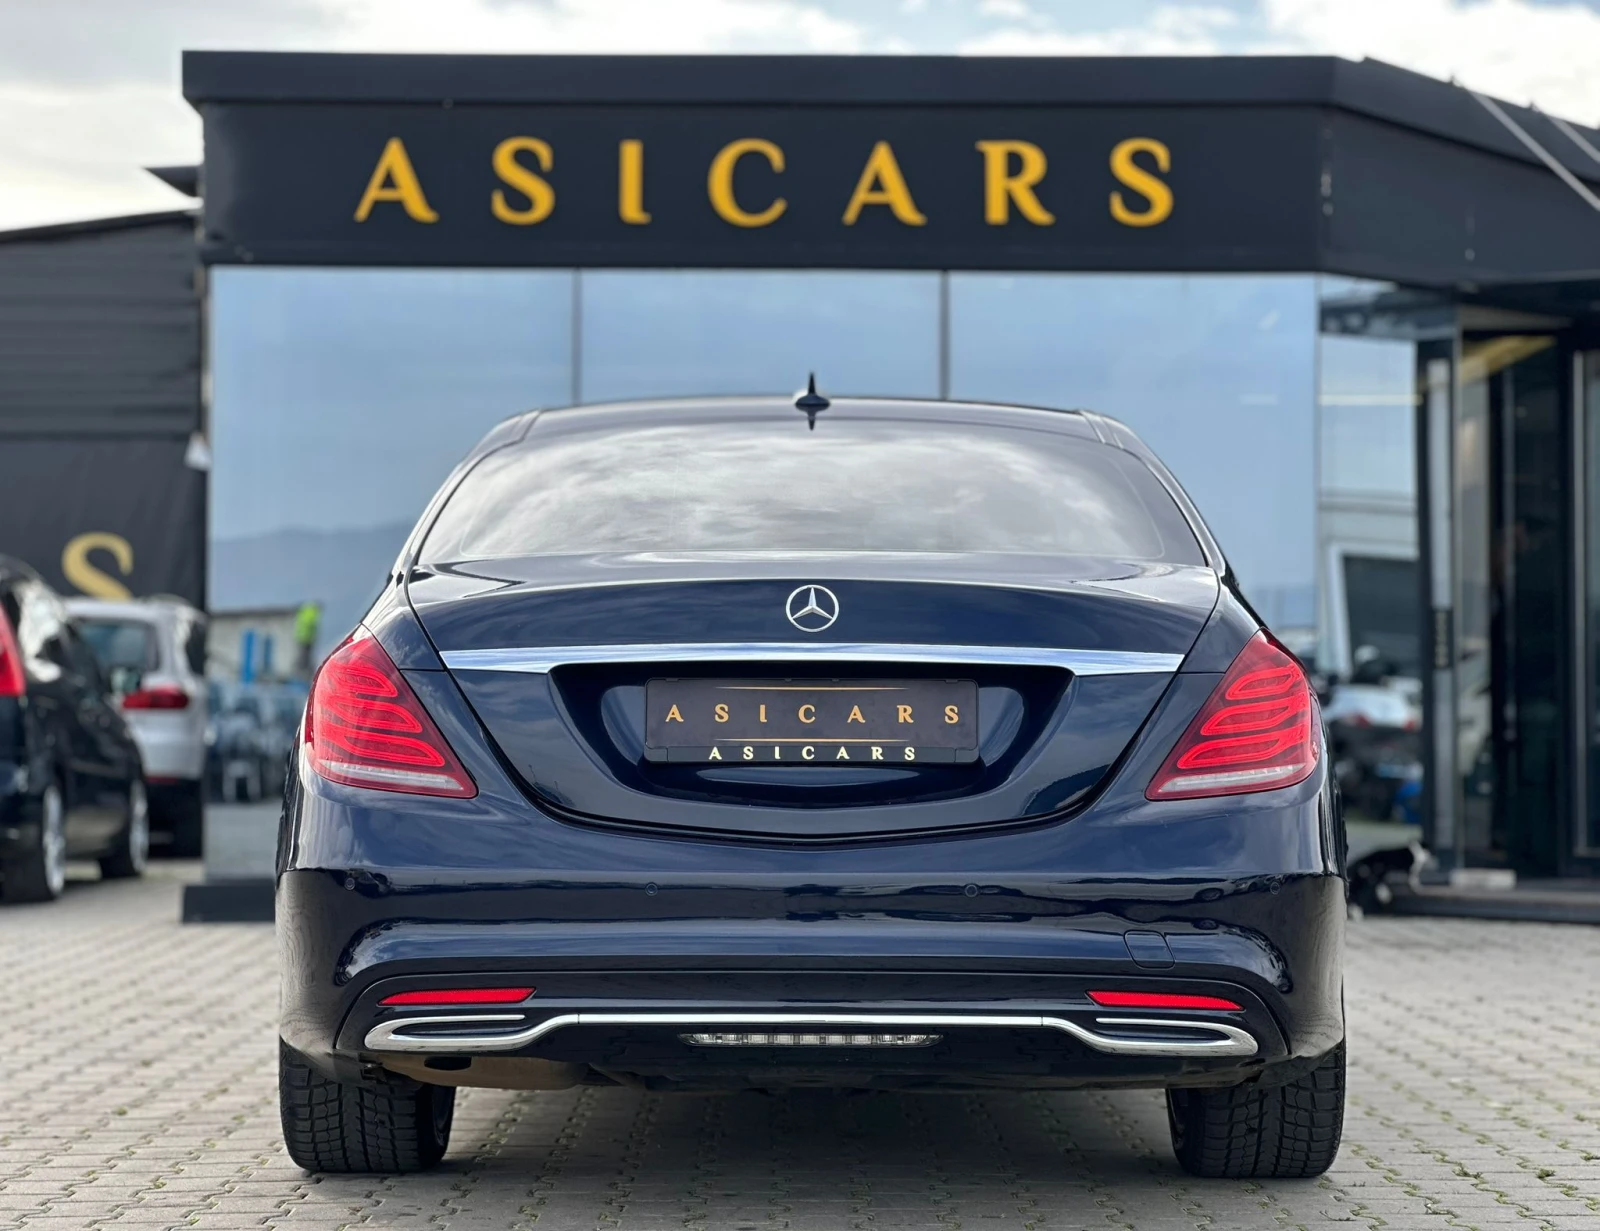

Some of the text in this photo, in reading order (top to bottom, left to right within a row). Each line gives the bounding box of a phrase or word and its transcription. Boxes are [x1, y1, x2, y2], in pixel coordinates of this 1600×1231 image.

[354, 136, 1176, 228] ASICARS
[665, 703, 961, 725] ASICARS
[708, 745, 917, 761] ASICARS
